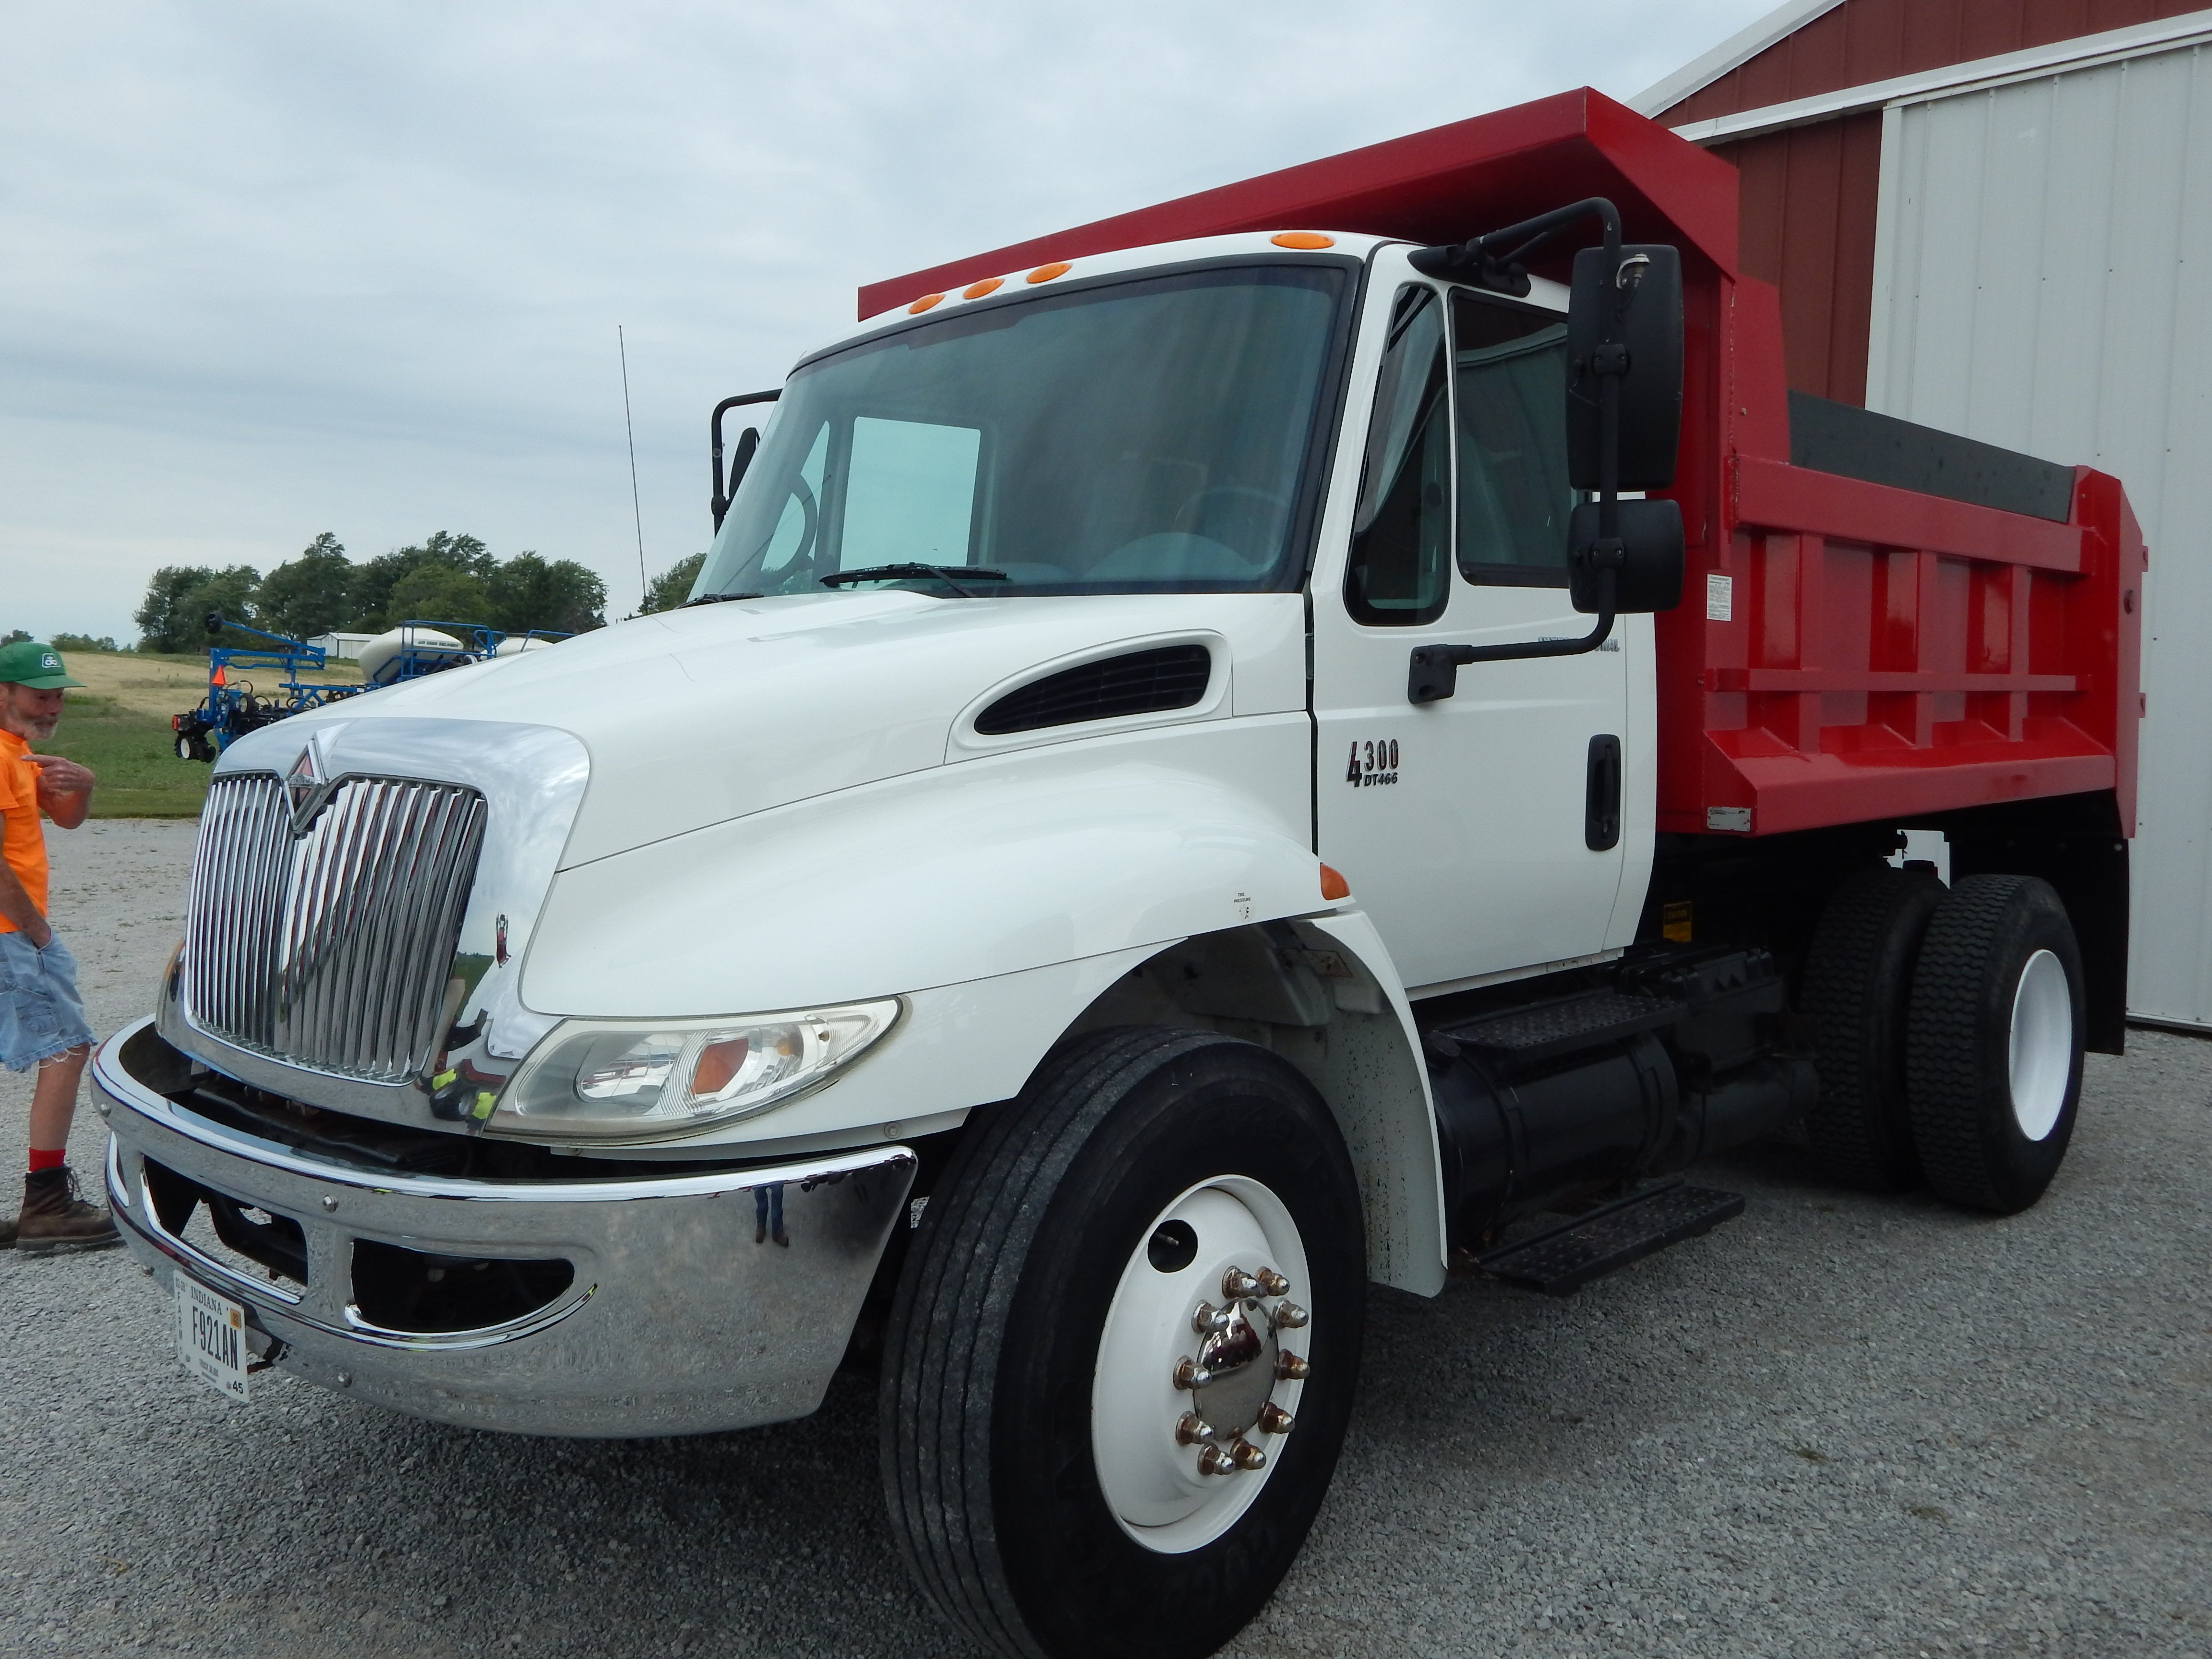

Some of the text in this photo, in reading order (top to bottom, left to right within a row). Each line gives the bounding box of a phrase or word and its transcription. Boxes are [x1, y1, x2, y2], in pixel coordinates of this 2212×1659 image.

[1346, 738, 1399, 788] 4300
[1364, 771, 1398, 787] DT466
[191, 1286, 222, 1316] INDIANA
[192, 1305, 238, 1371] F921AN
[233, 1380, 244, 1395] 45
